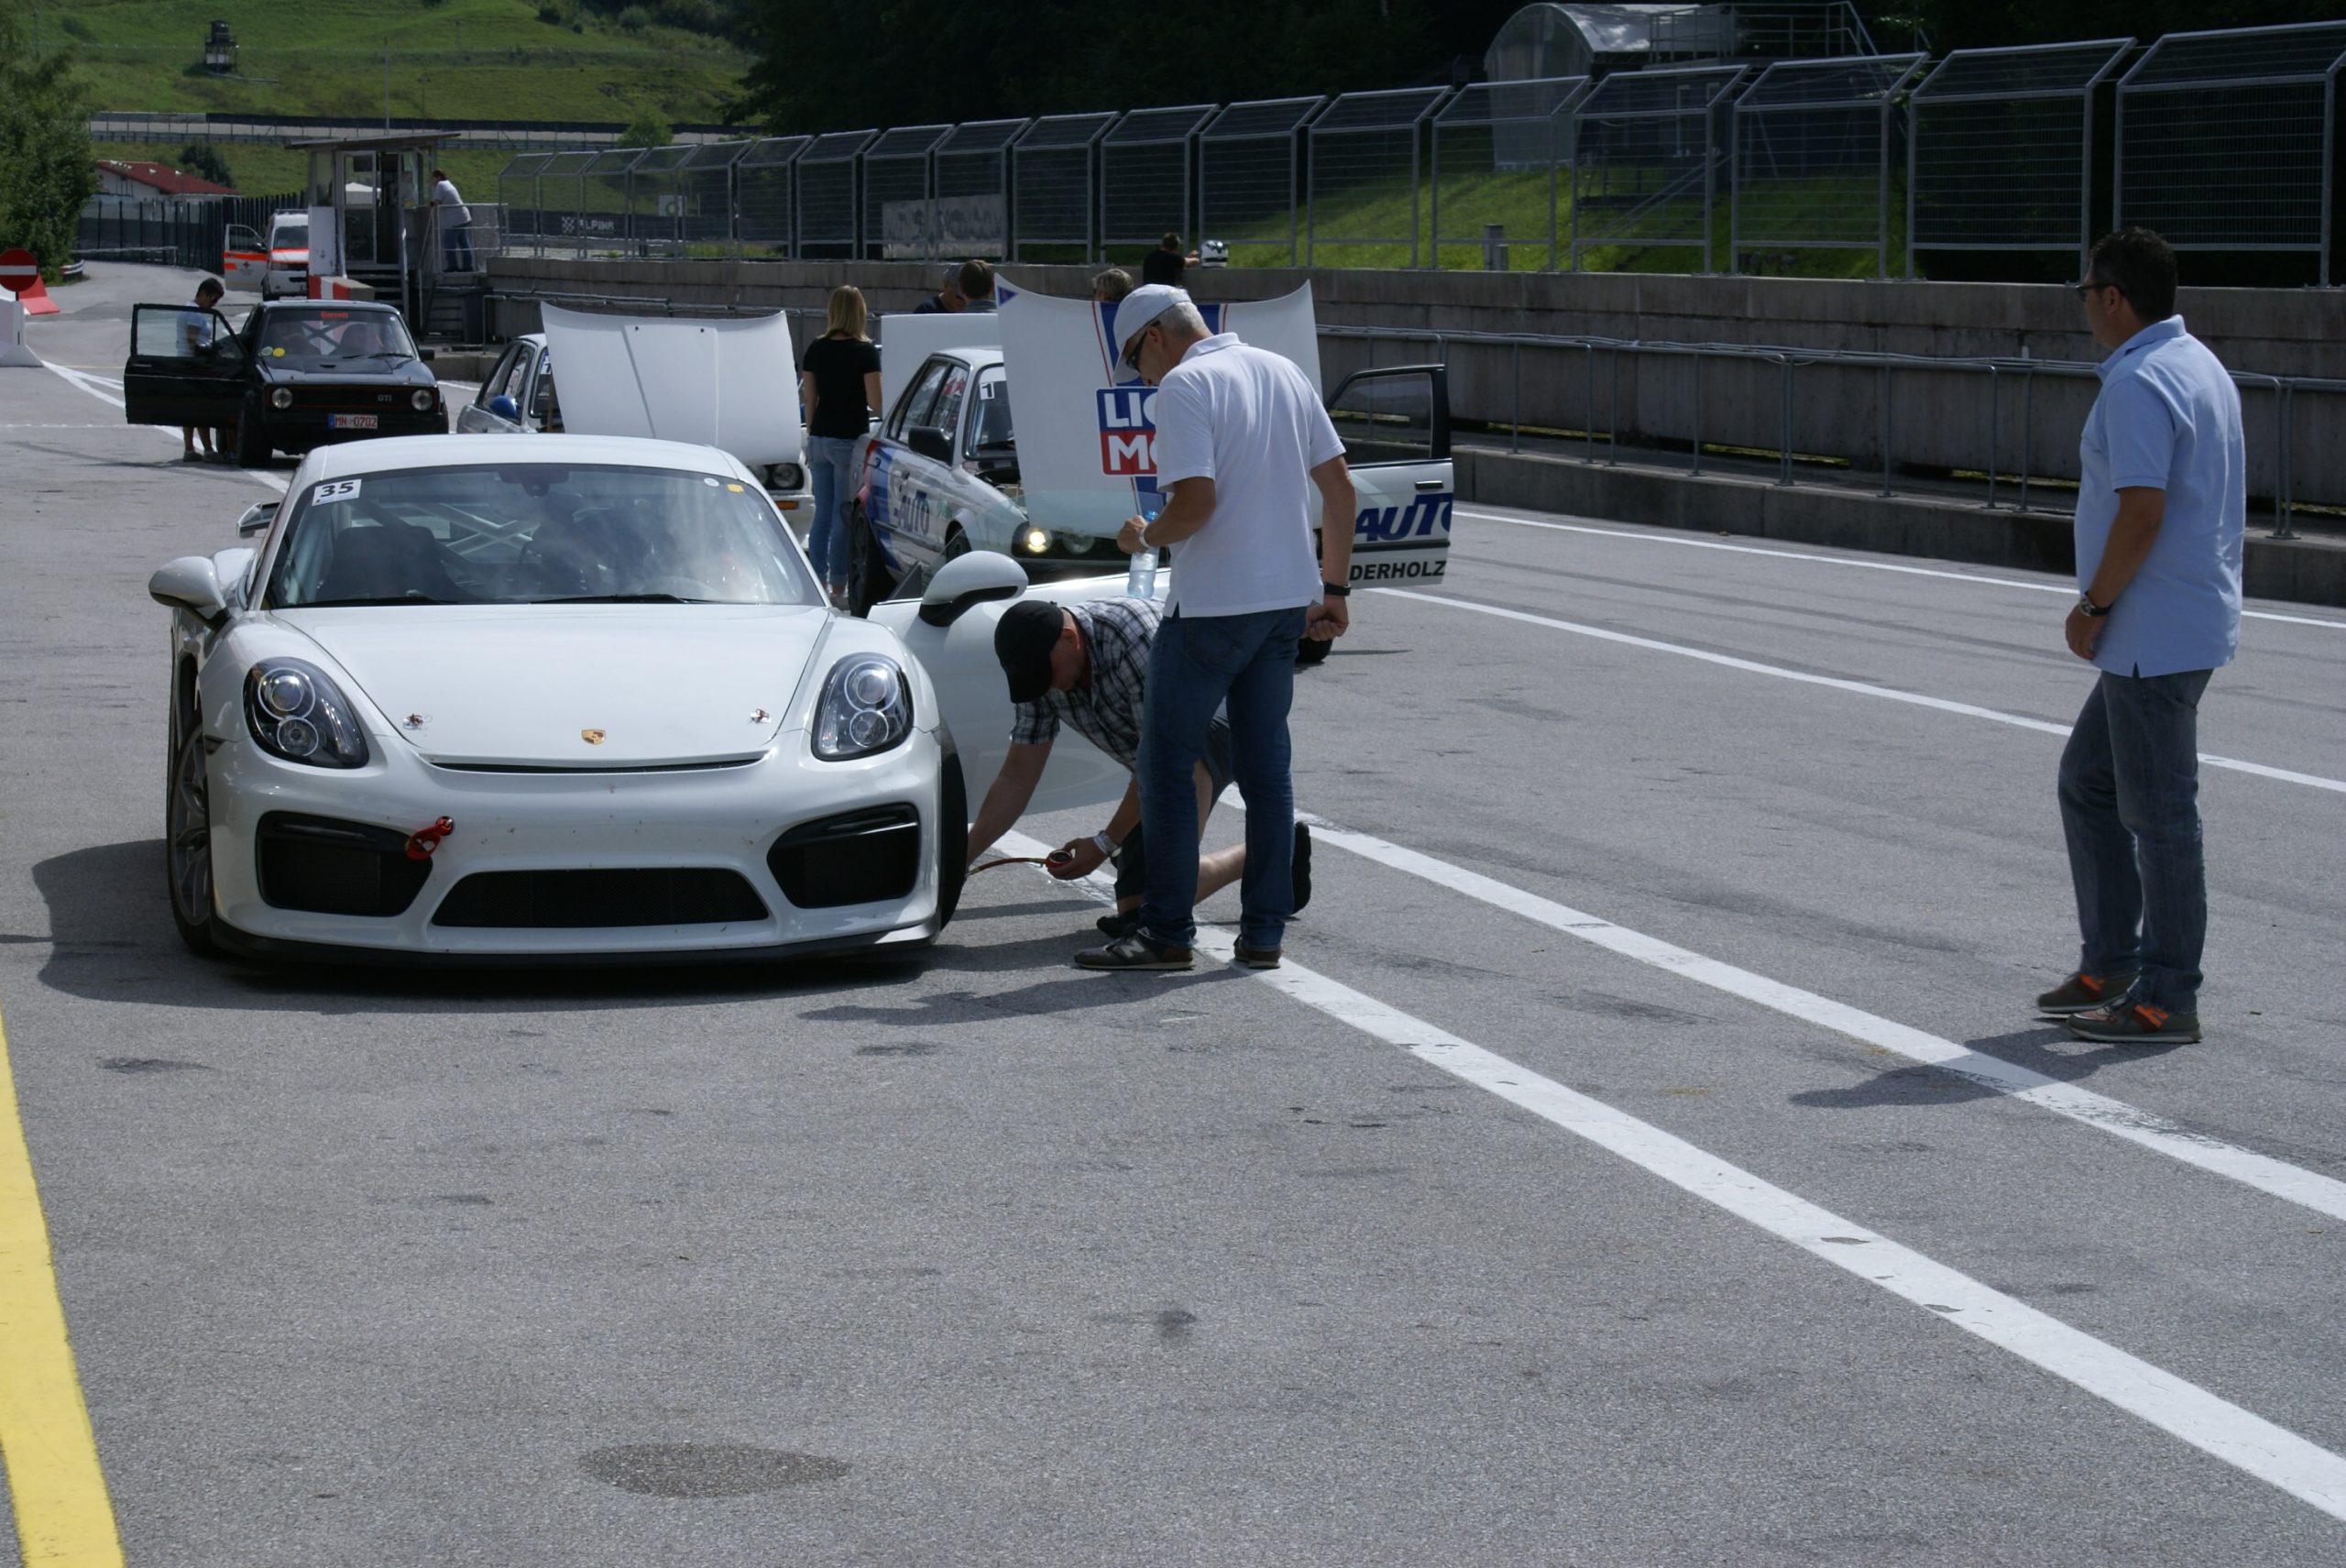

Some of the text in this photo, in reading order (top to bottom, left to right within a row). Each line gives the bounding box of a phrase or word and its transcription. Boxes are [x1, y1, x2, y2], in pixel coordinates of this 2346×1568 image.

[981, 383, 992, 398] 1
[377, 394, 392, 402] GTI
[334, 416, 347, 426] MN
[321, 482, 354, 498] 35
